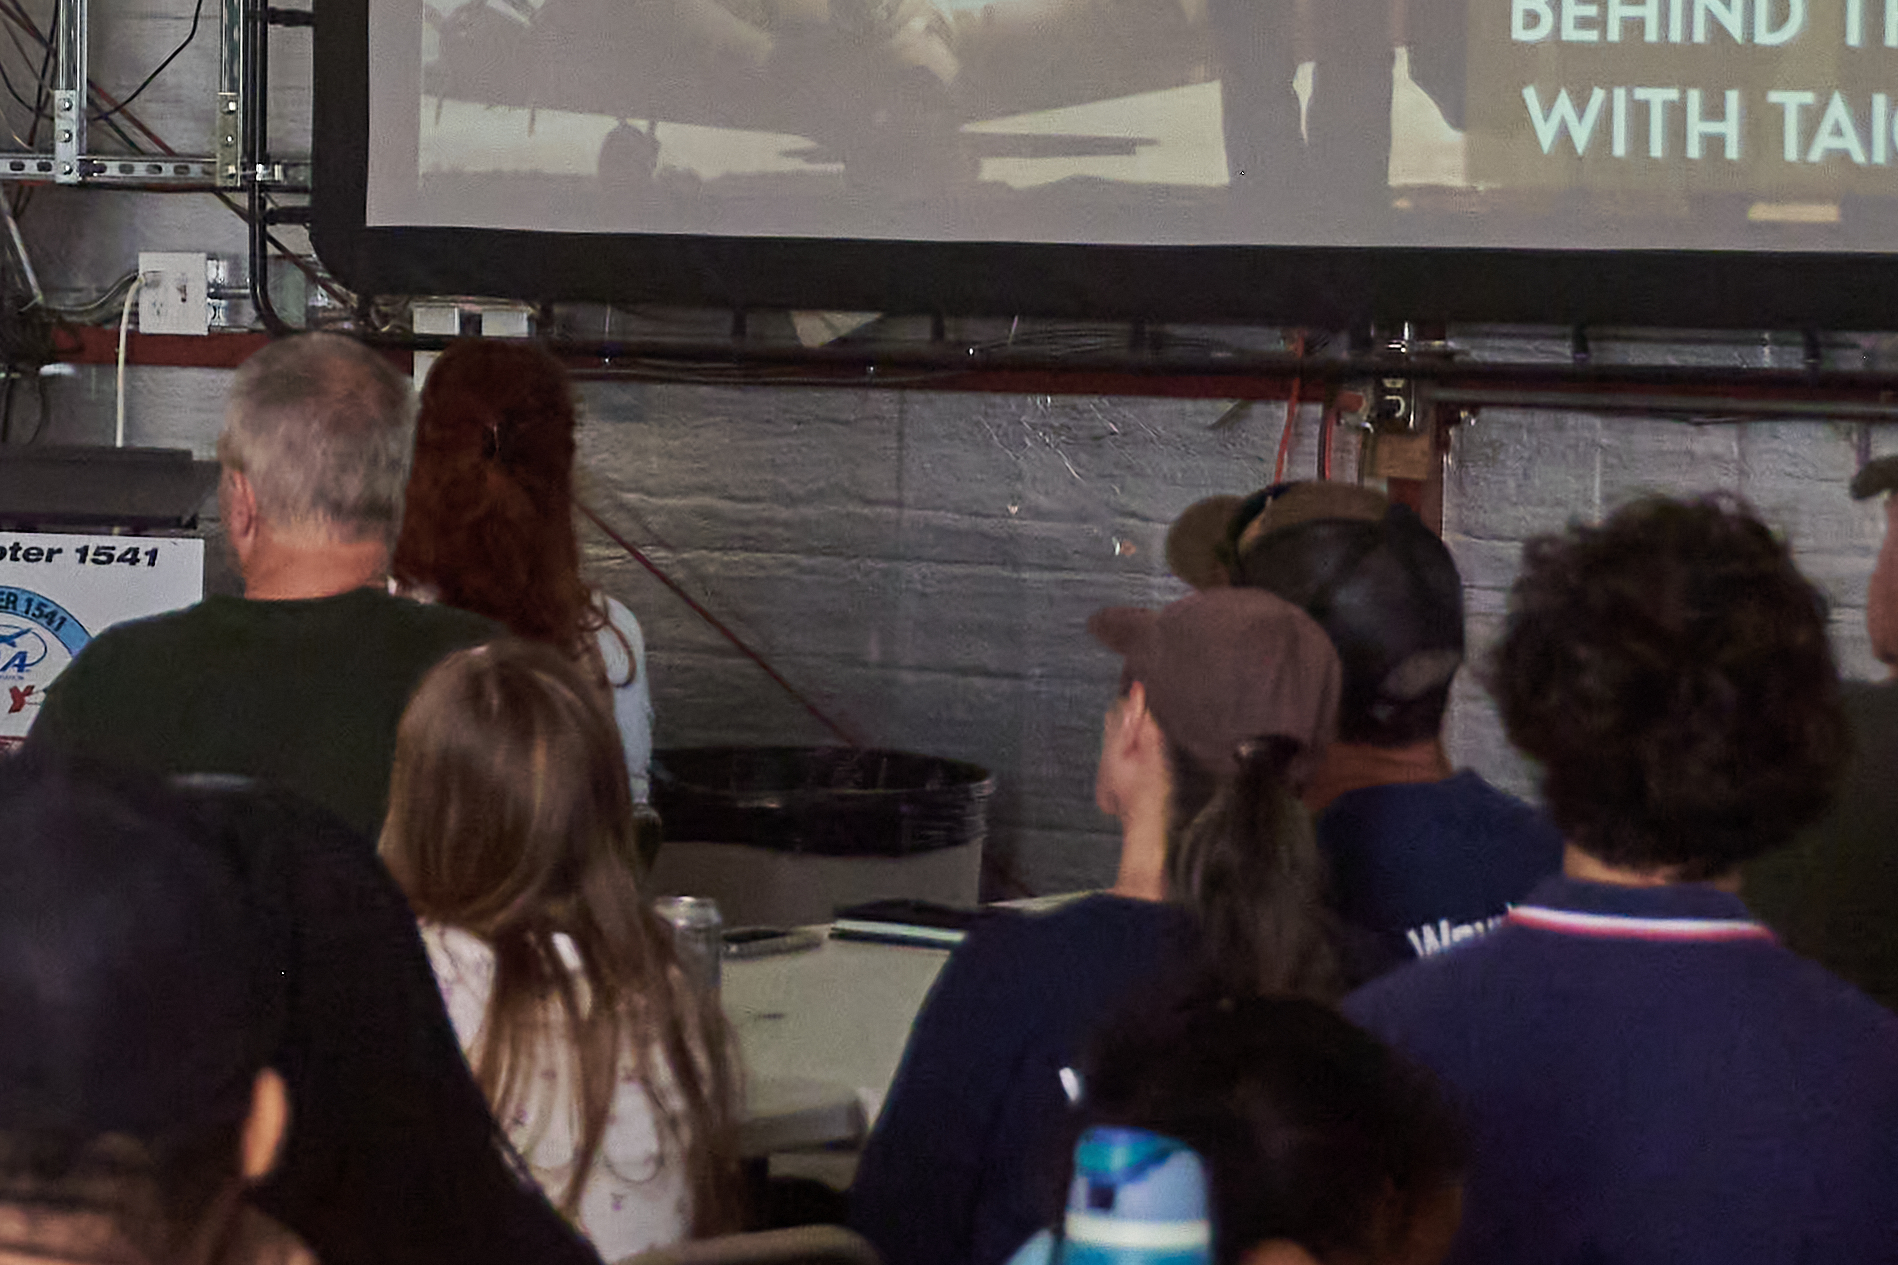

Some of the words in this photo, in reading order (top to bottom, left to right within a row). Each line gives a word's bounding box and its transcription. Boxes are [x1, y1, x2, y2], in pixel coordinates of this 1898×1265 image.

[1522, 85, 1741, 160] WITH
[1767, 90, 1898, 165] TAI
[74, 545, 159, 567] 1541
[23, 597, 67, 632] 1541
